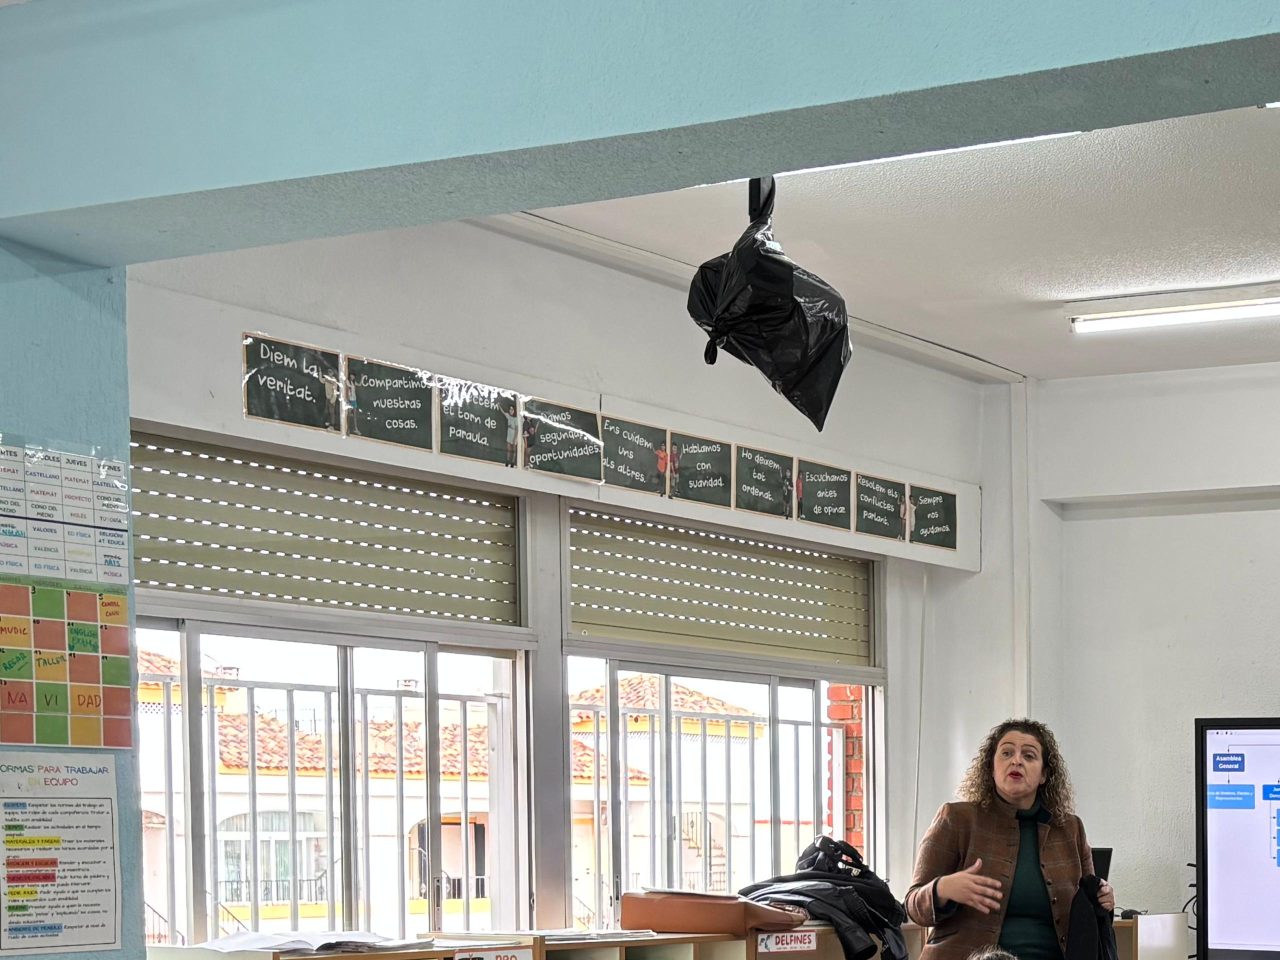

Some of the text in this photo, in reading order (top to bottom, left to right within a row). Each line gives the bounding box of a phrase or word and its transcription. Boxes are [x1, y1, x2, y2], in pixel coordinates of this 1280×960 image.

[260, 343, 318, 375] Diem la
[257, 374, 315, 403] veritat.
[373, 396, 422, 409] nuestras
[443, 404, 497, 429] el torn de
[385, 419, 418, 429] cosas.
[449, 426, 489, 446] paraula.
[604, 420, 652, 450] Ens cuidem
[529, 445, 602, 465] oportunidades.
[618, 445, 634, 460] uns
[682, 443, 721, 455] Hablamos
[66, 458, 87, 467] JUEVES
[741, 448, 780, 470] Ho deixem
[602, 456, 646, 483] als altres.
[696, 463, 712, 471] con
[25, 470, 60, 480] CASTELLANO
[752, 468, 766, 482] tot
[805, 472, 848, 482] Escuchamos
[688, 476, 725, 489] suavidad.
[857, 475, 899, 499] Resolem els
[741, 484, 774, 501] ordenat.
[816, 490, 838, 498] antes
[860, 492, 895, 512] conflictes
[918, 495, 944, 506] Siempre
[813, 504, 822, 514] de
[8, 691, 102, 708] NA VI DAD
[37, 765, 61, 774] PARA
[64, 766, 110, 775] TRABAJAR
[43, 777, 79, 786] EQUIPO
[775, 934, 812, 946] DELFINES
